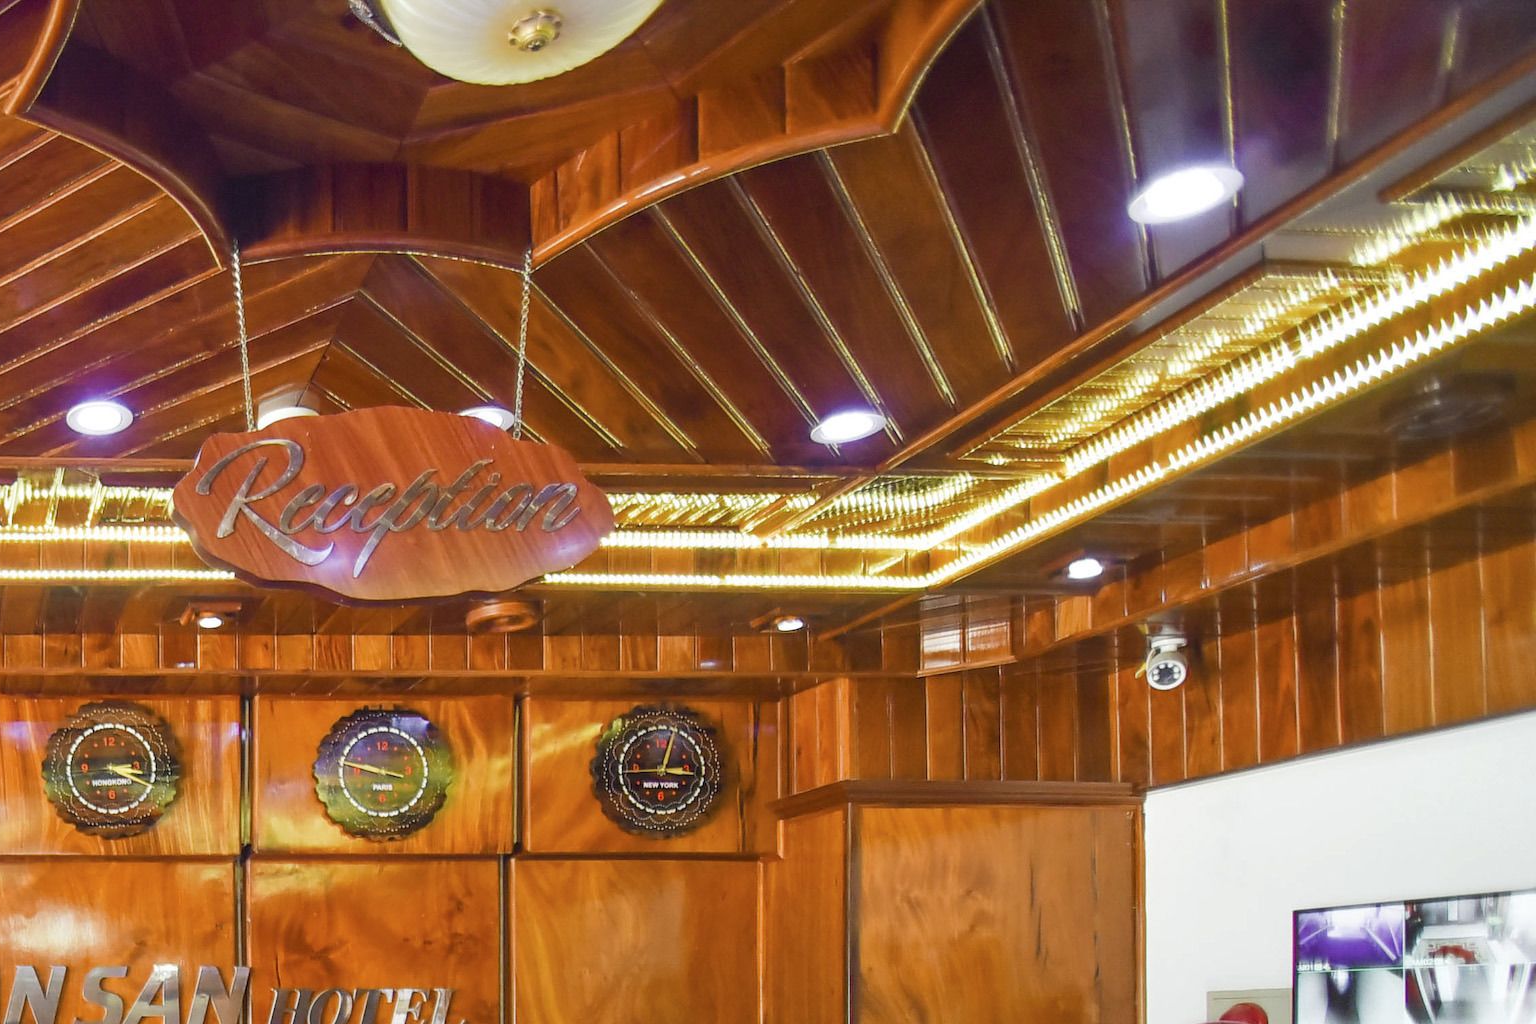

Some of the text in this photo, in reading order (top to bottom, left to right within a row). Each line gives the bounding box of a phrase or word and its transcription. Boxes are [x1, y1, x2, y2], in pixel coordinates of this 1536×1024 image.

[195, 438, 581, 579] Reception
[103, 737, 115, 747] 12
[81, 763, 89, 773] 9
[91, 778, 133, 787] HONGKONG
[372, 783, 393, 791] PARIS
[643, 781, 679, 789] NEW YORK
[108, 790, 116, 800] 6
[657, 791, 665, 801] 6
